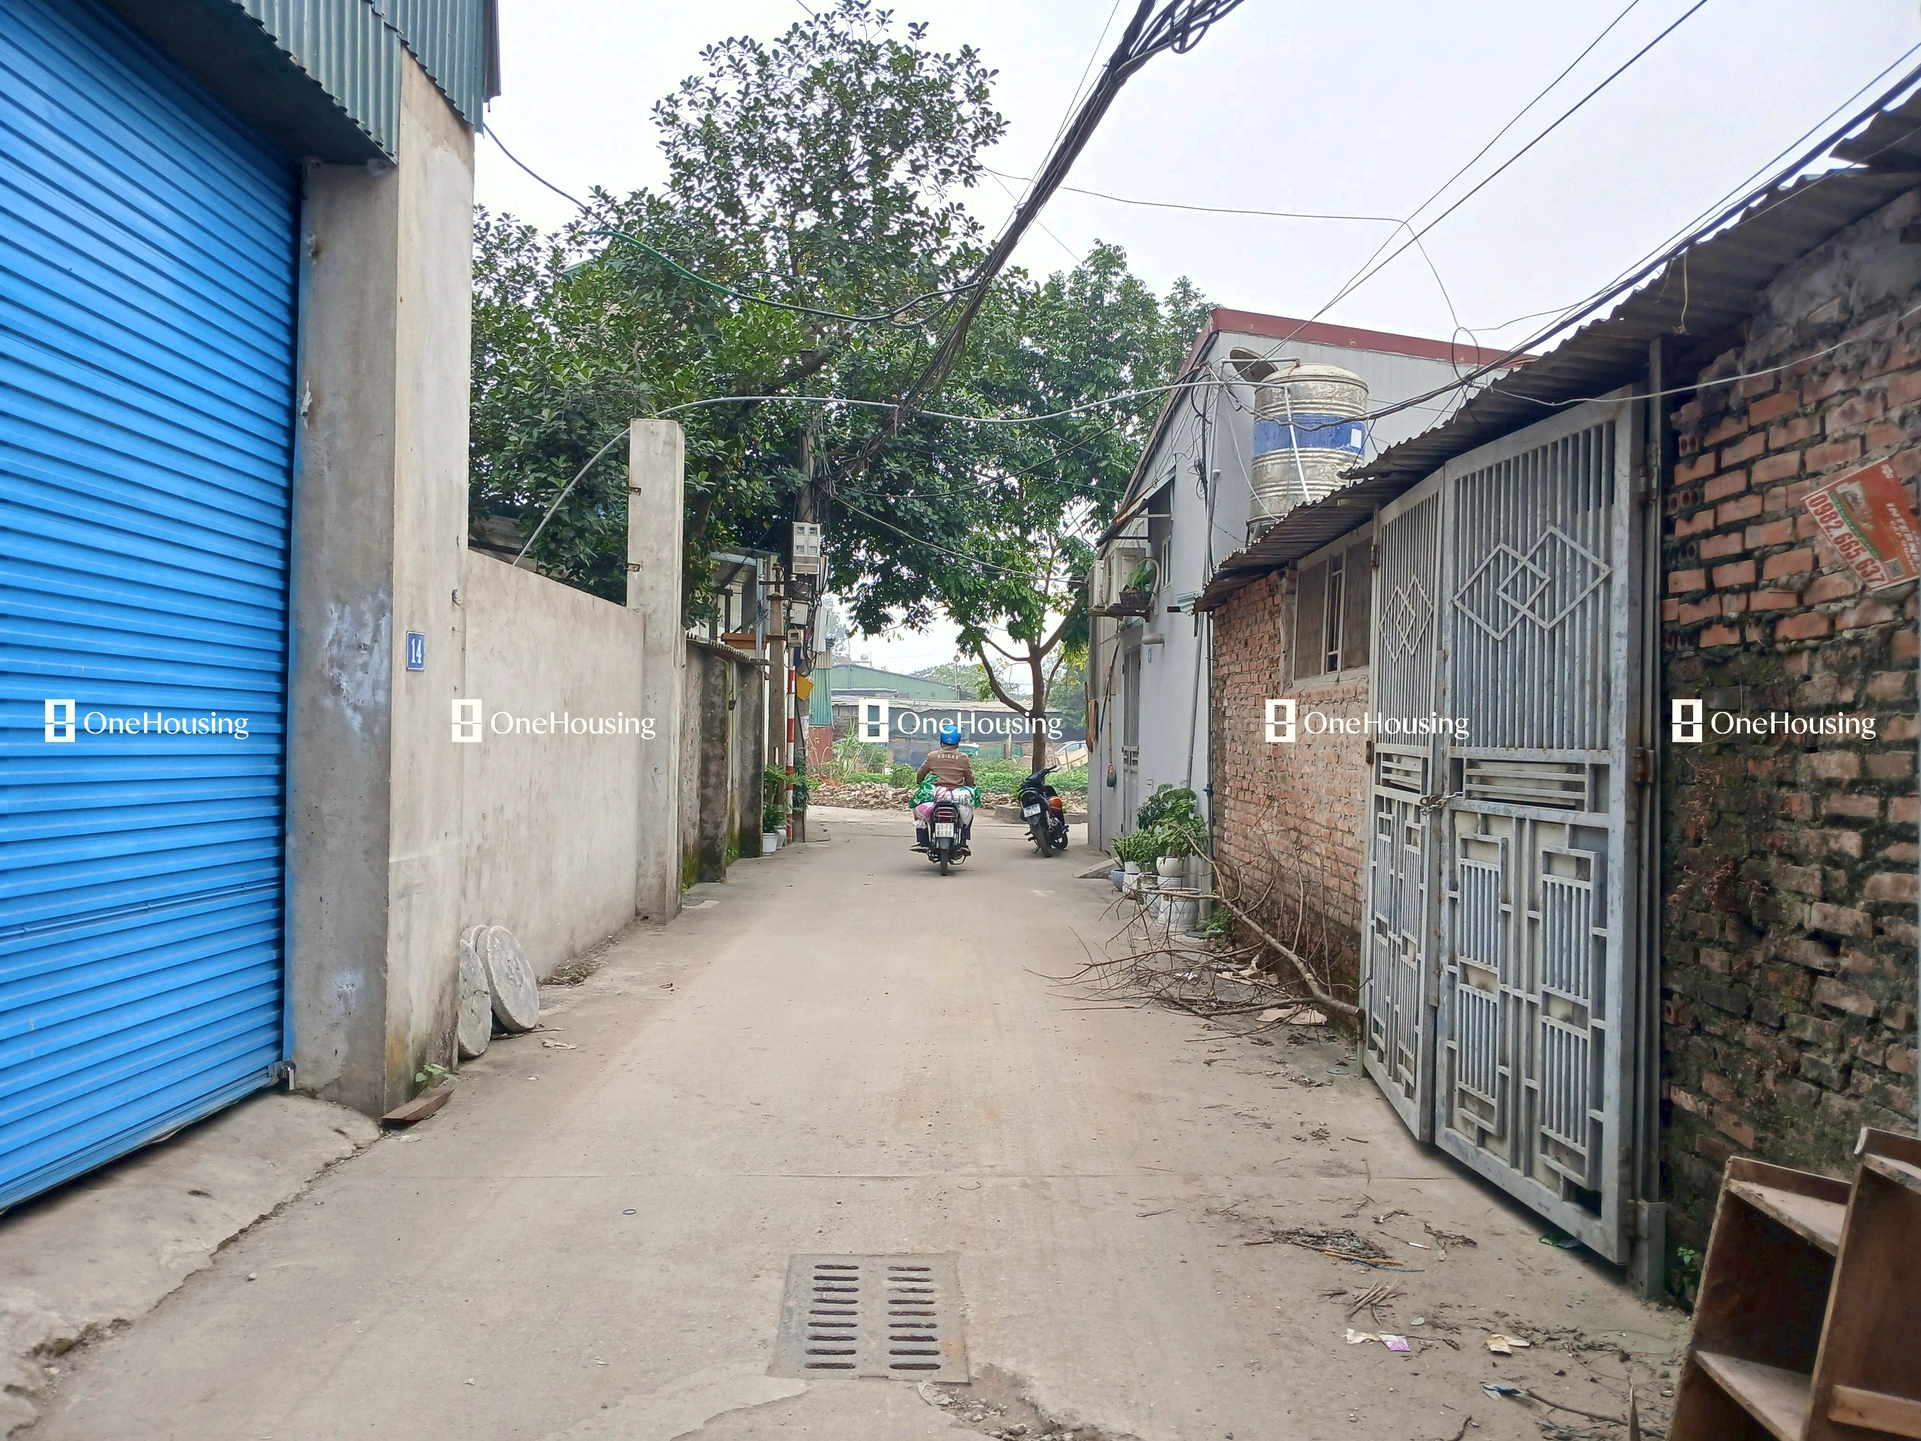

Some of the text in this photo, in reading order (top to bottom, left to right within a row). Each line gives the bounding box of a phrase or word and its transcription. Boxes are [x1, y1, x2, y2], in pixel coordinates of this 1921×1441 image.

[1808, 494, 1886, 584] 0982.665.637
[1887, 503, 1920, 568] INTERNE
[411, 638, 422, 664] 14
